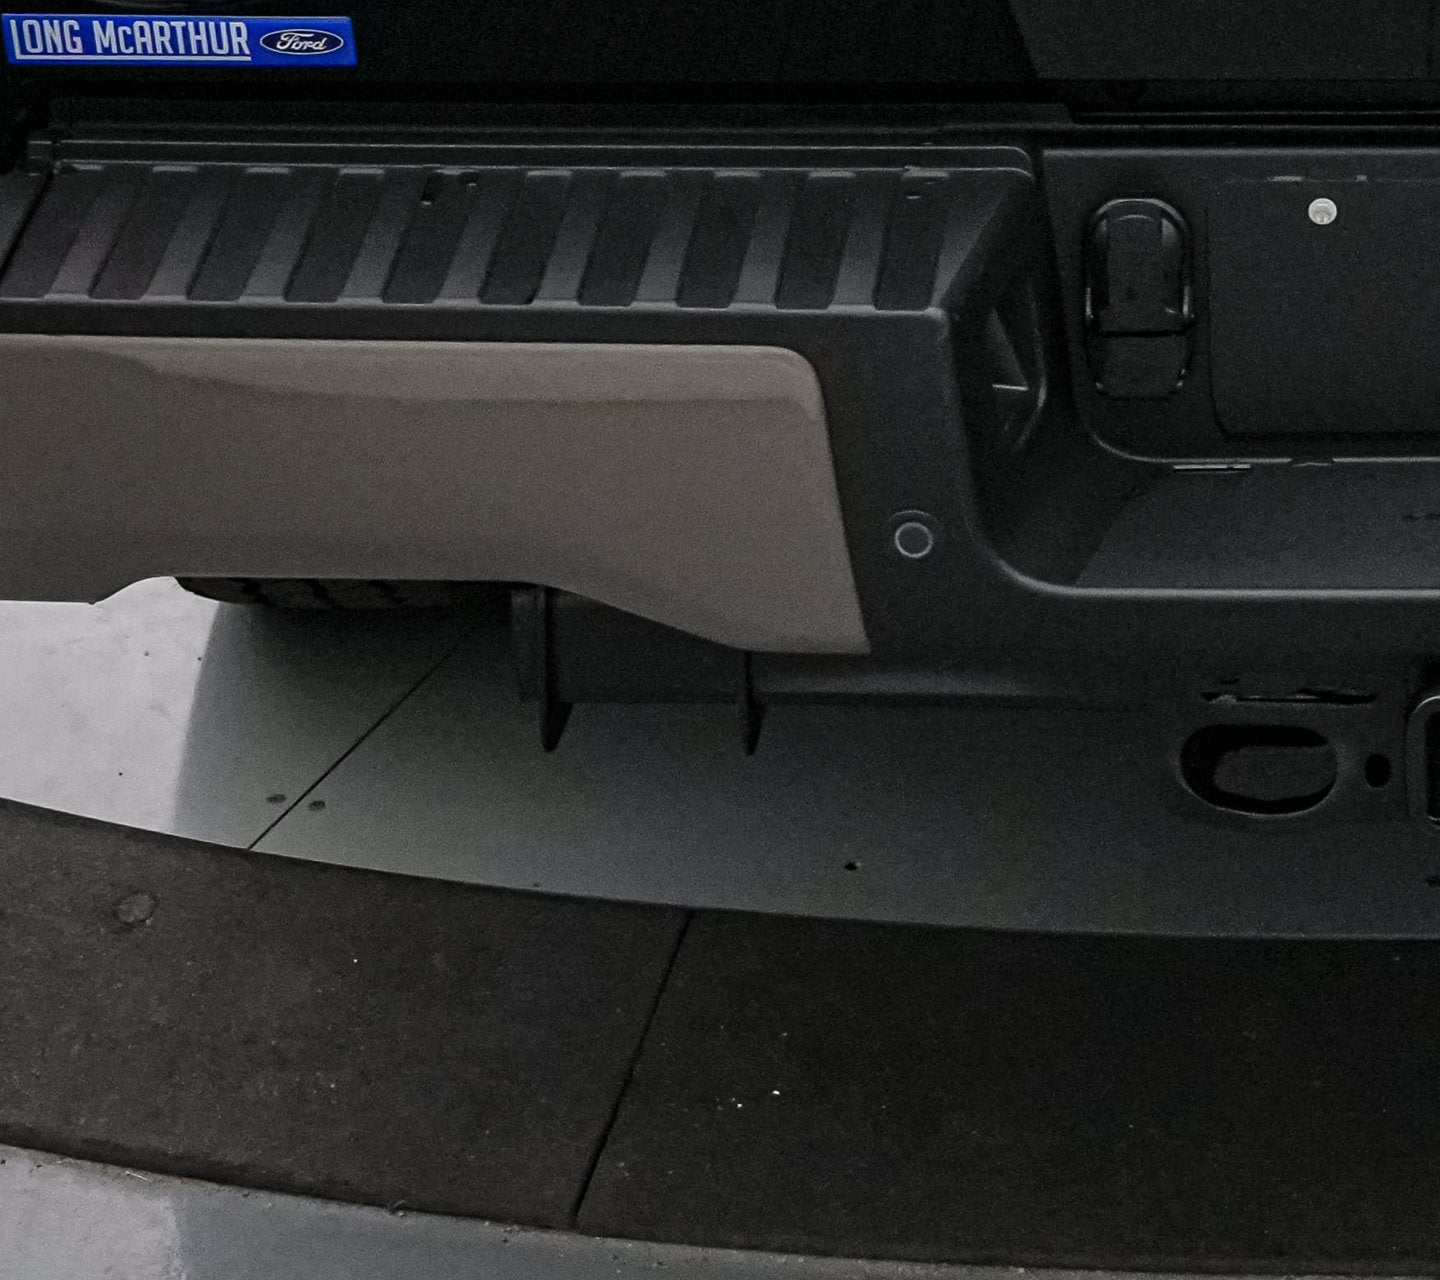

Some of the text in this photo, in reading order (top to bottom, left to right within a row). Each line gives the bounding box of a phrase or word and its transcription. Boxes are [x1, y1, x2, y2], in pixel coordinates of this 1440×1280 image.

[9, 18, 328, 58] LONG McARTHUR Ford
